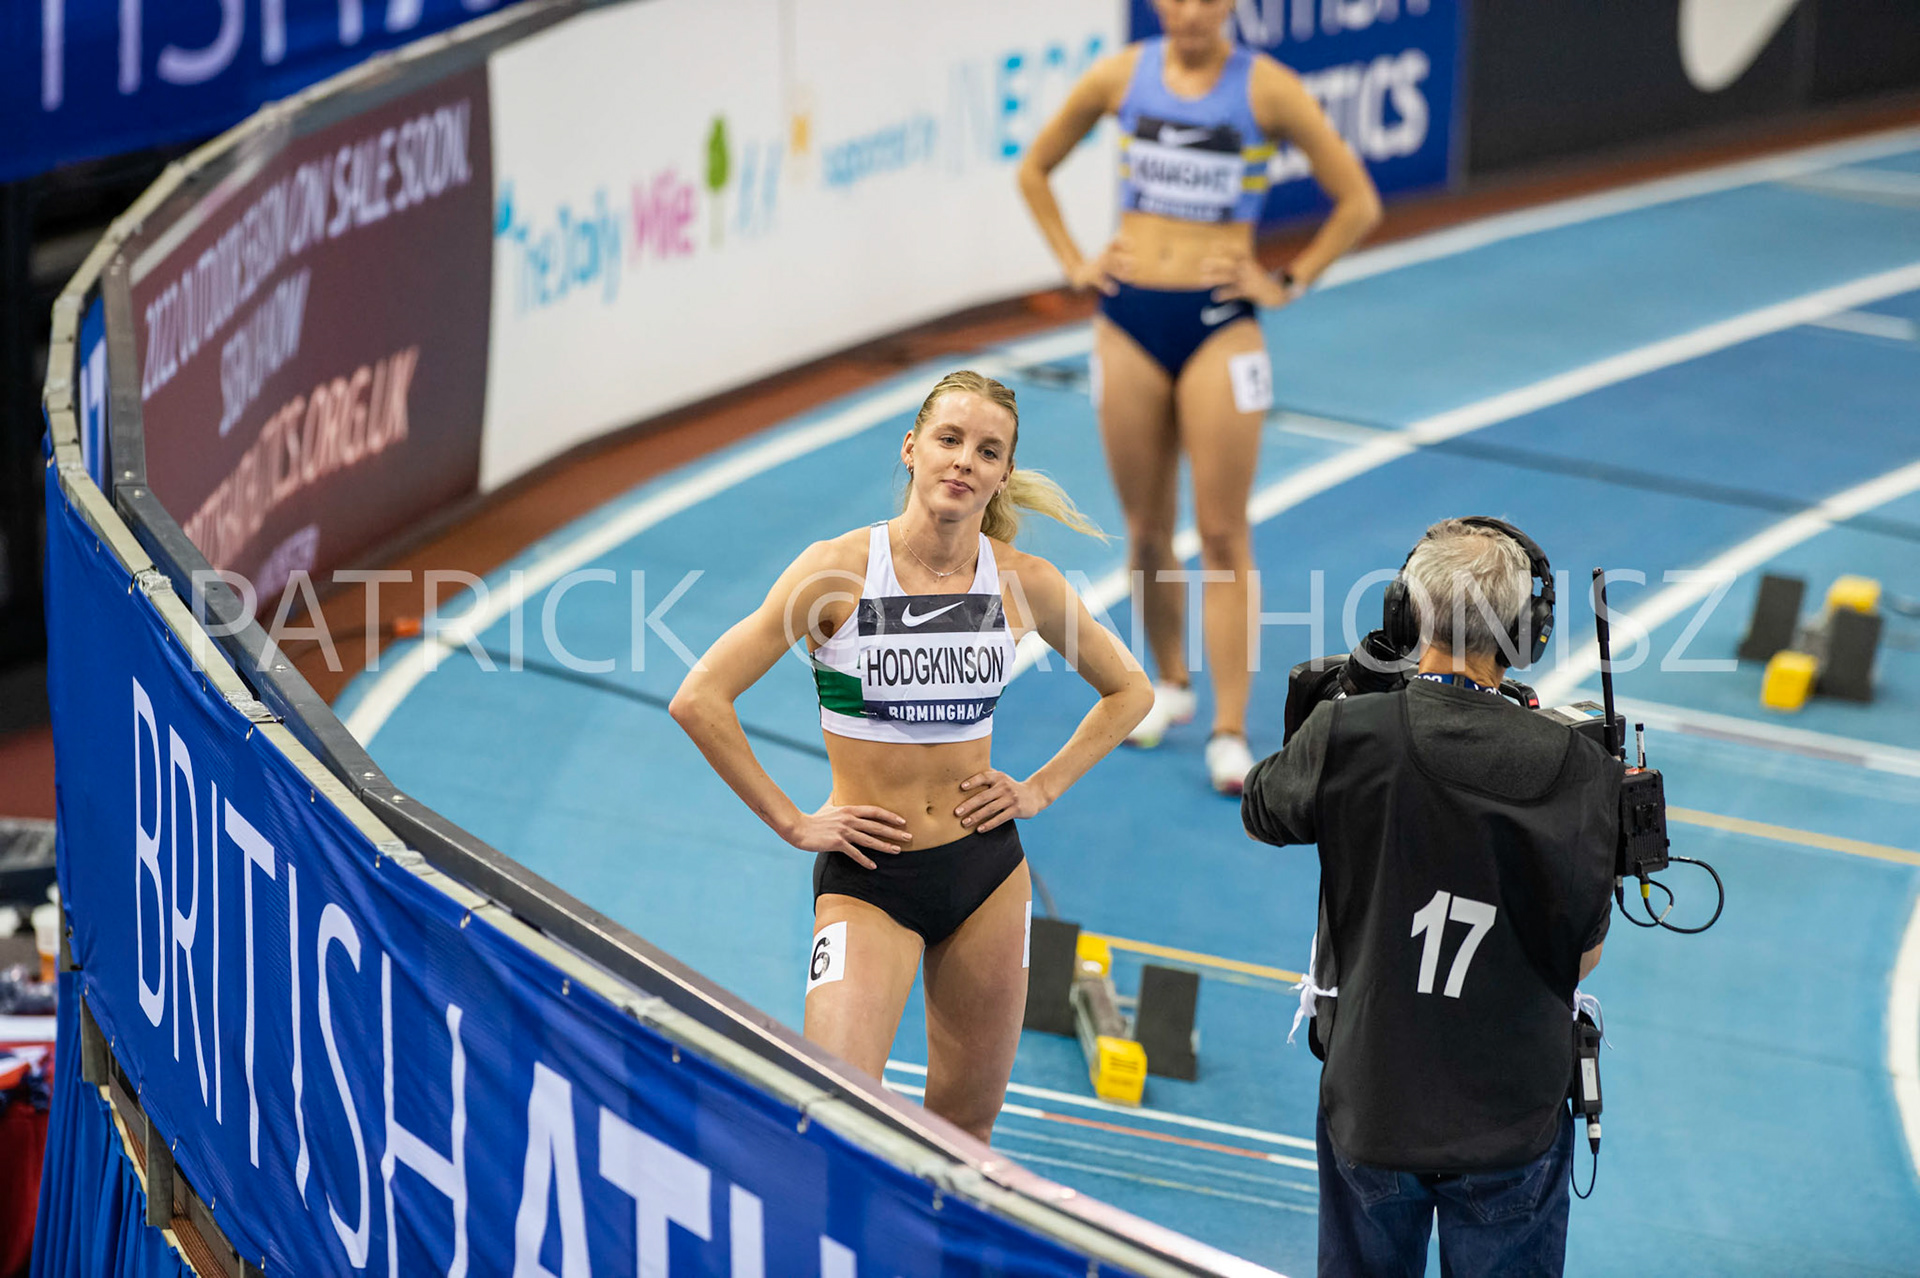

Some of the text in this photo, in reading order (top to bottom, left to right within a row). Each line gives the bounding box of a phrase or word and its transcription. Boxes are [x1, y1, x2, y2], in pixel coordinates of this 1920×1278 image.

[328, 127, 395, 237] SALE
[867, 646, 1004, 687] HODGKINSON
[132, 675, 464, 1278] BRITISH
[810, 936, 831, 982] 6
[1410, 889, 1498, 999] 17
